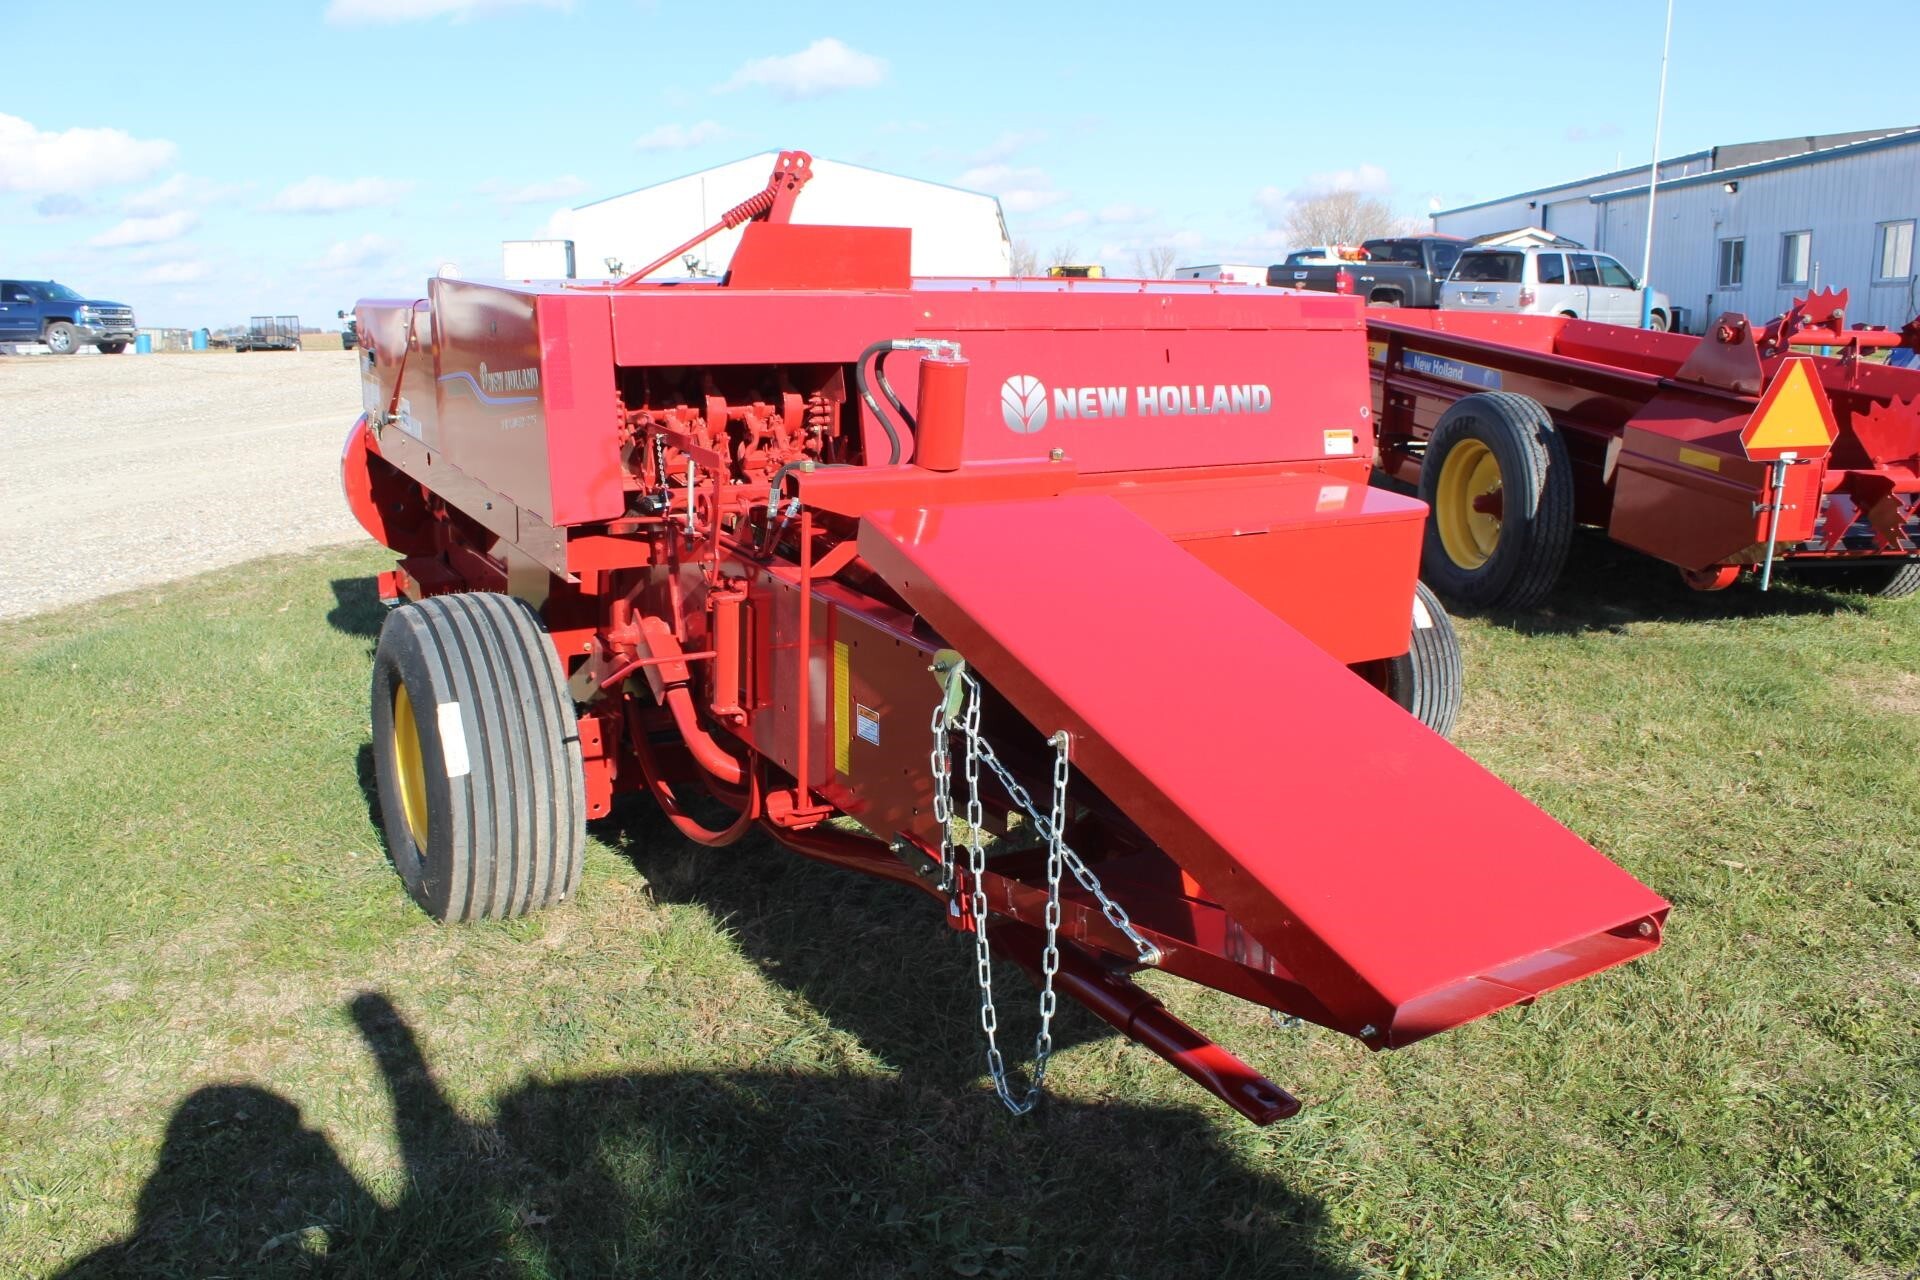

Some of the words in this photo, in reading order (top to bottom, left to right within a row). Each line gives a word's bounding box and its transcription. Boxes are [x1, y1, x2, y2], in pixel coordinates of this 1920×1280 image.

[1413, 355, 1431, 372] New
[1432, 360, 1464, 380] Holland
[1053, 387, 1127, 420] NEW
[1136, 384, 1272, 416] HOLLAND
